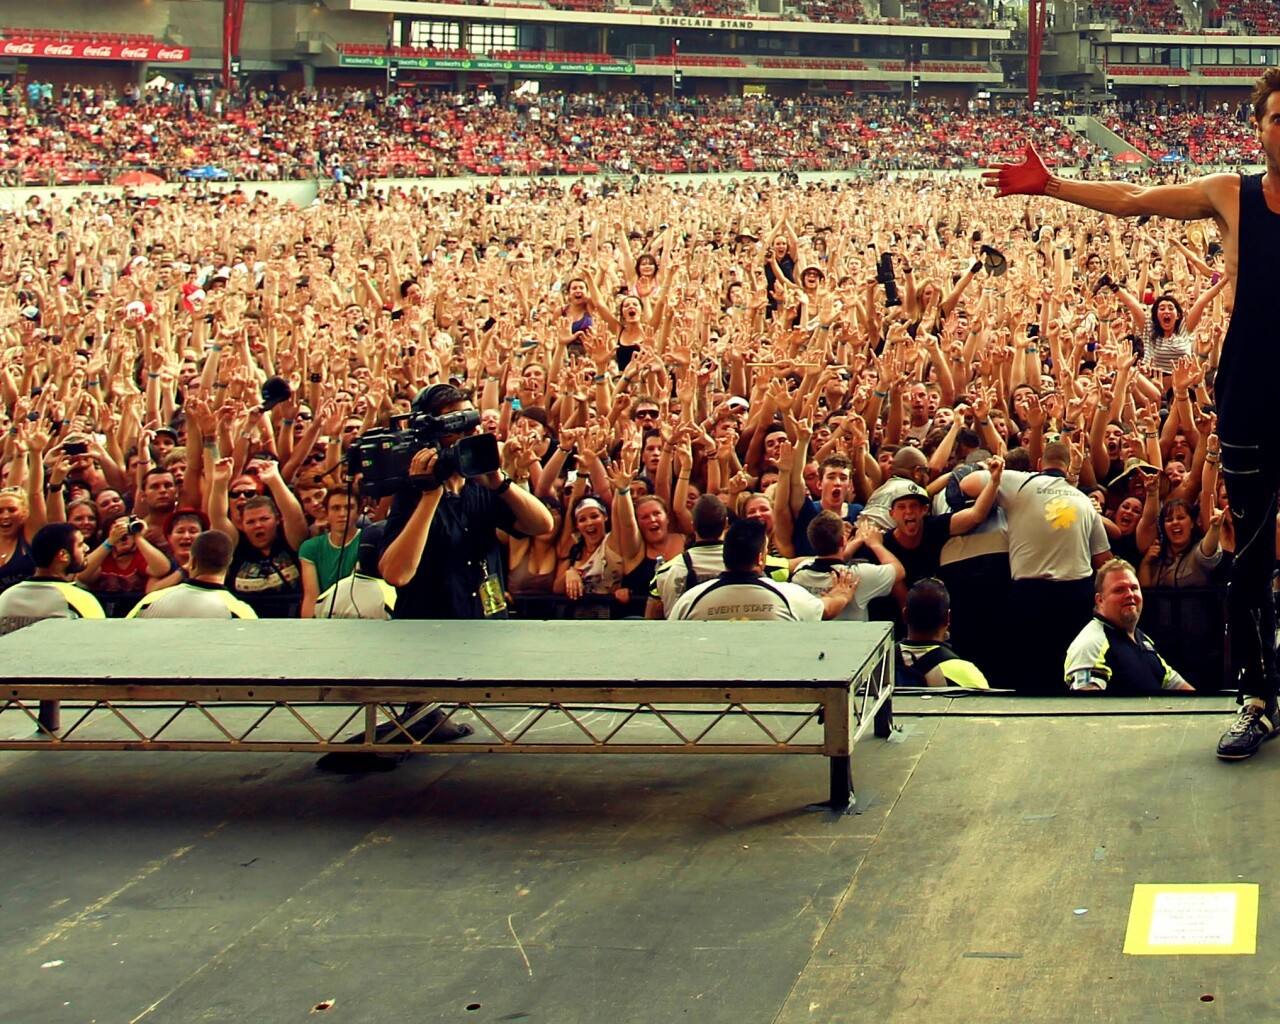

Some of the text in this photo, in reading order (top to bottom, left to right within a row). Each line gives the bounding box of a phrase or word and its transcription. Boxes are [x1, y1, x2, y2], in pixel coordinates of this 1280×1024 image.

[660, 17, 754, 29] SINCLAIR STAND
[707, 604, 774, 616] EVENT STAFF
